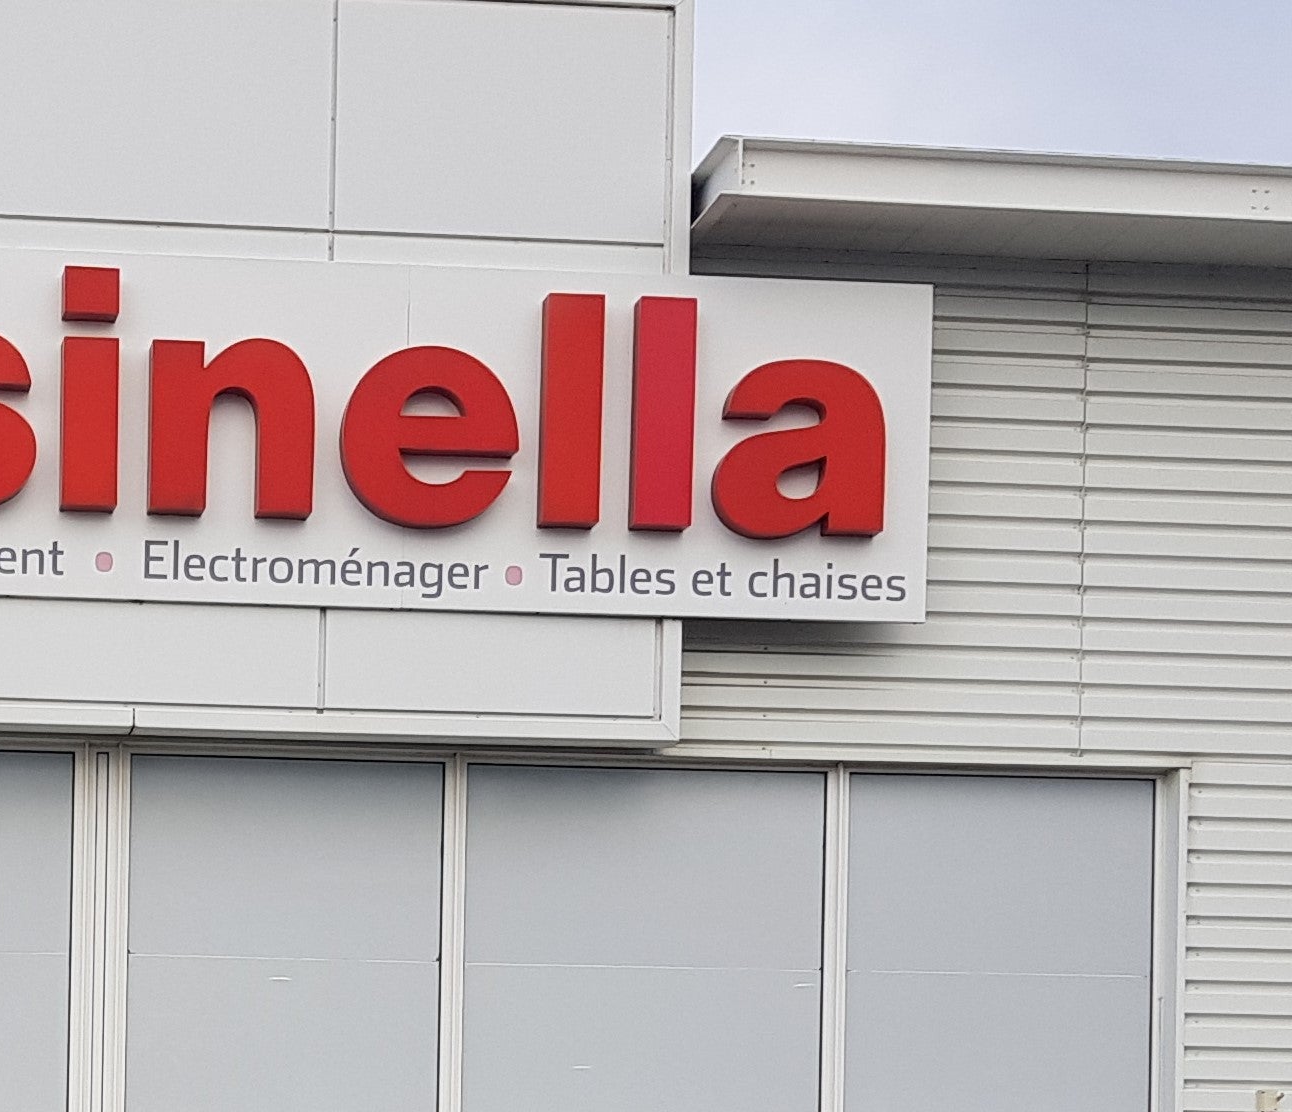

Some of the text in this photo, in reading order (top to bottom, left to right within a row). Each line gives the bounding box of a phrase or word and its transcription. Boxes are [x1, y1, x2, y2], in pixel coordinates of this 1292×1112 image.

[143, 539, 490, 598] Electroménager
[540, 554, 675, 596] Tables
[691, 566, 732, 596] et
[748, 561, 907, 602] chaises
